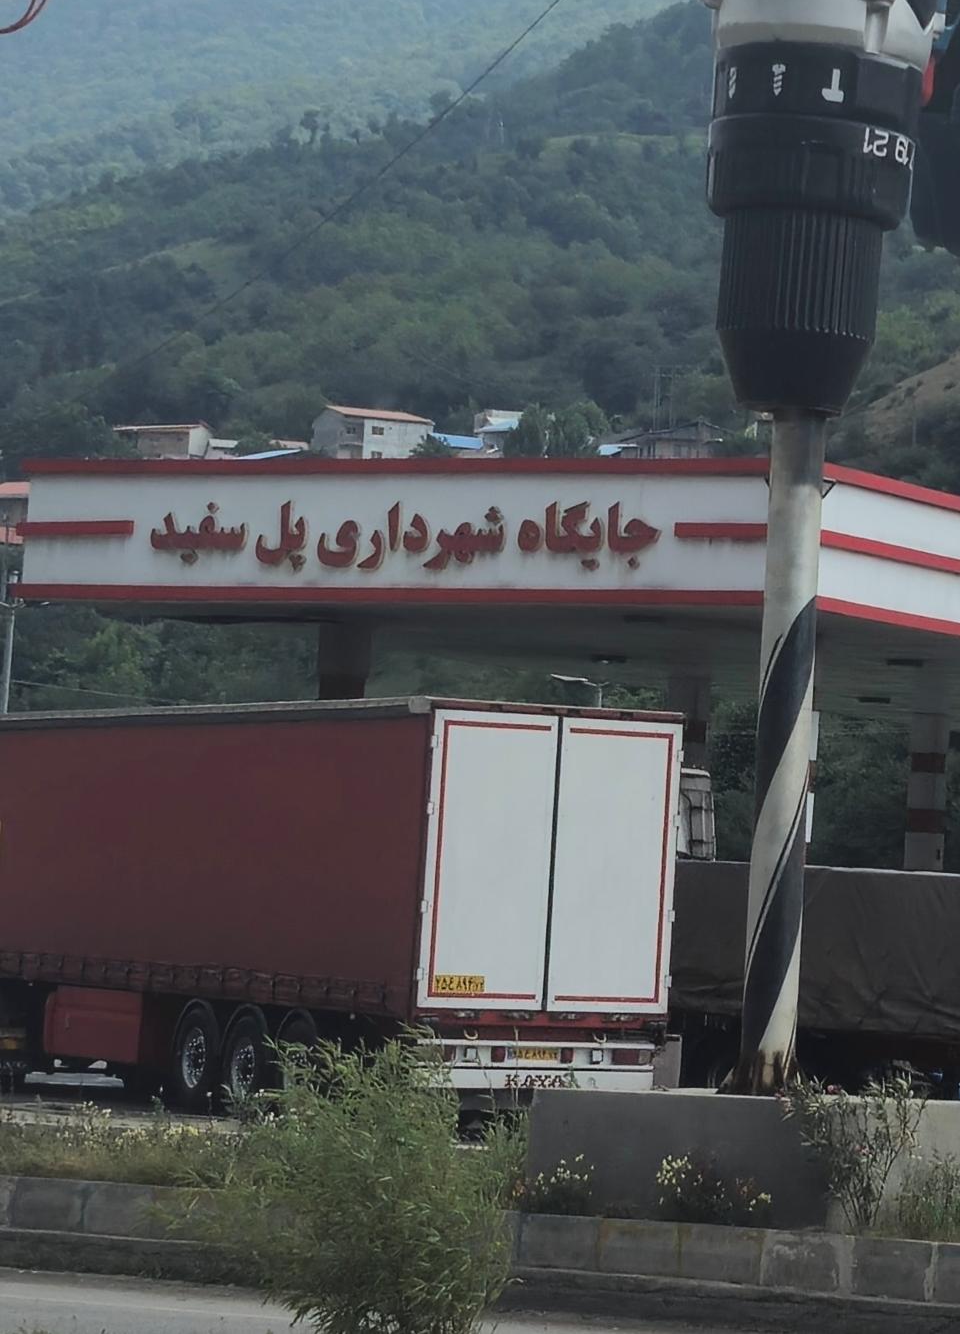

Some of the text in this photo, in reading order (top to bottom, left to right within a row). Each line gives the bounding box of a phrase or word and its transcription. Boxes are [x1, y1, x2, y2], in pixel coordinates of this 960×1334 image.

[863, 126, 889, 157] 21
[150, 499, 662, 572] جایگاه شهرداری پل سفید
